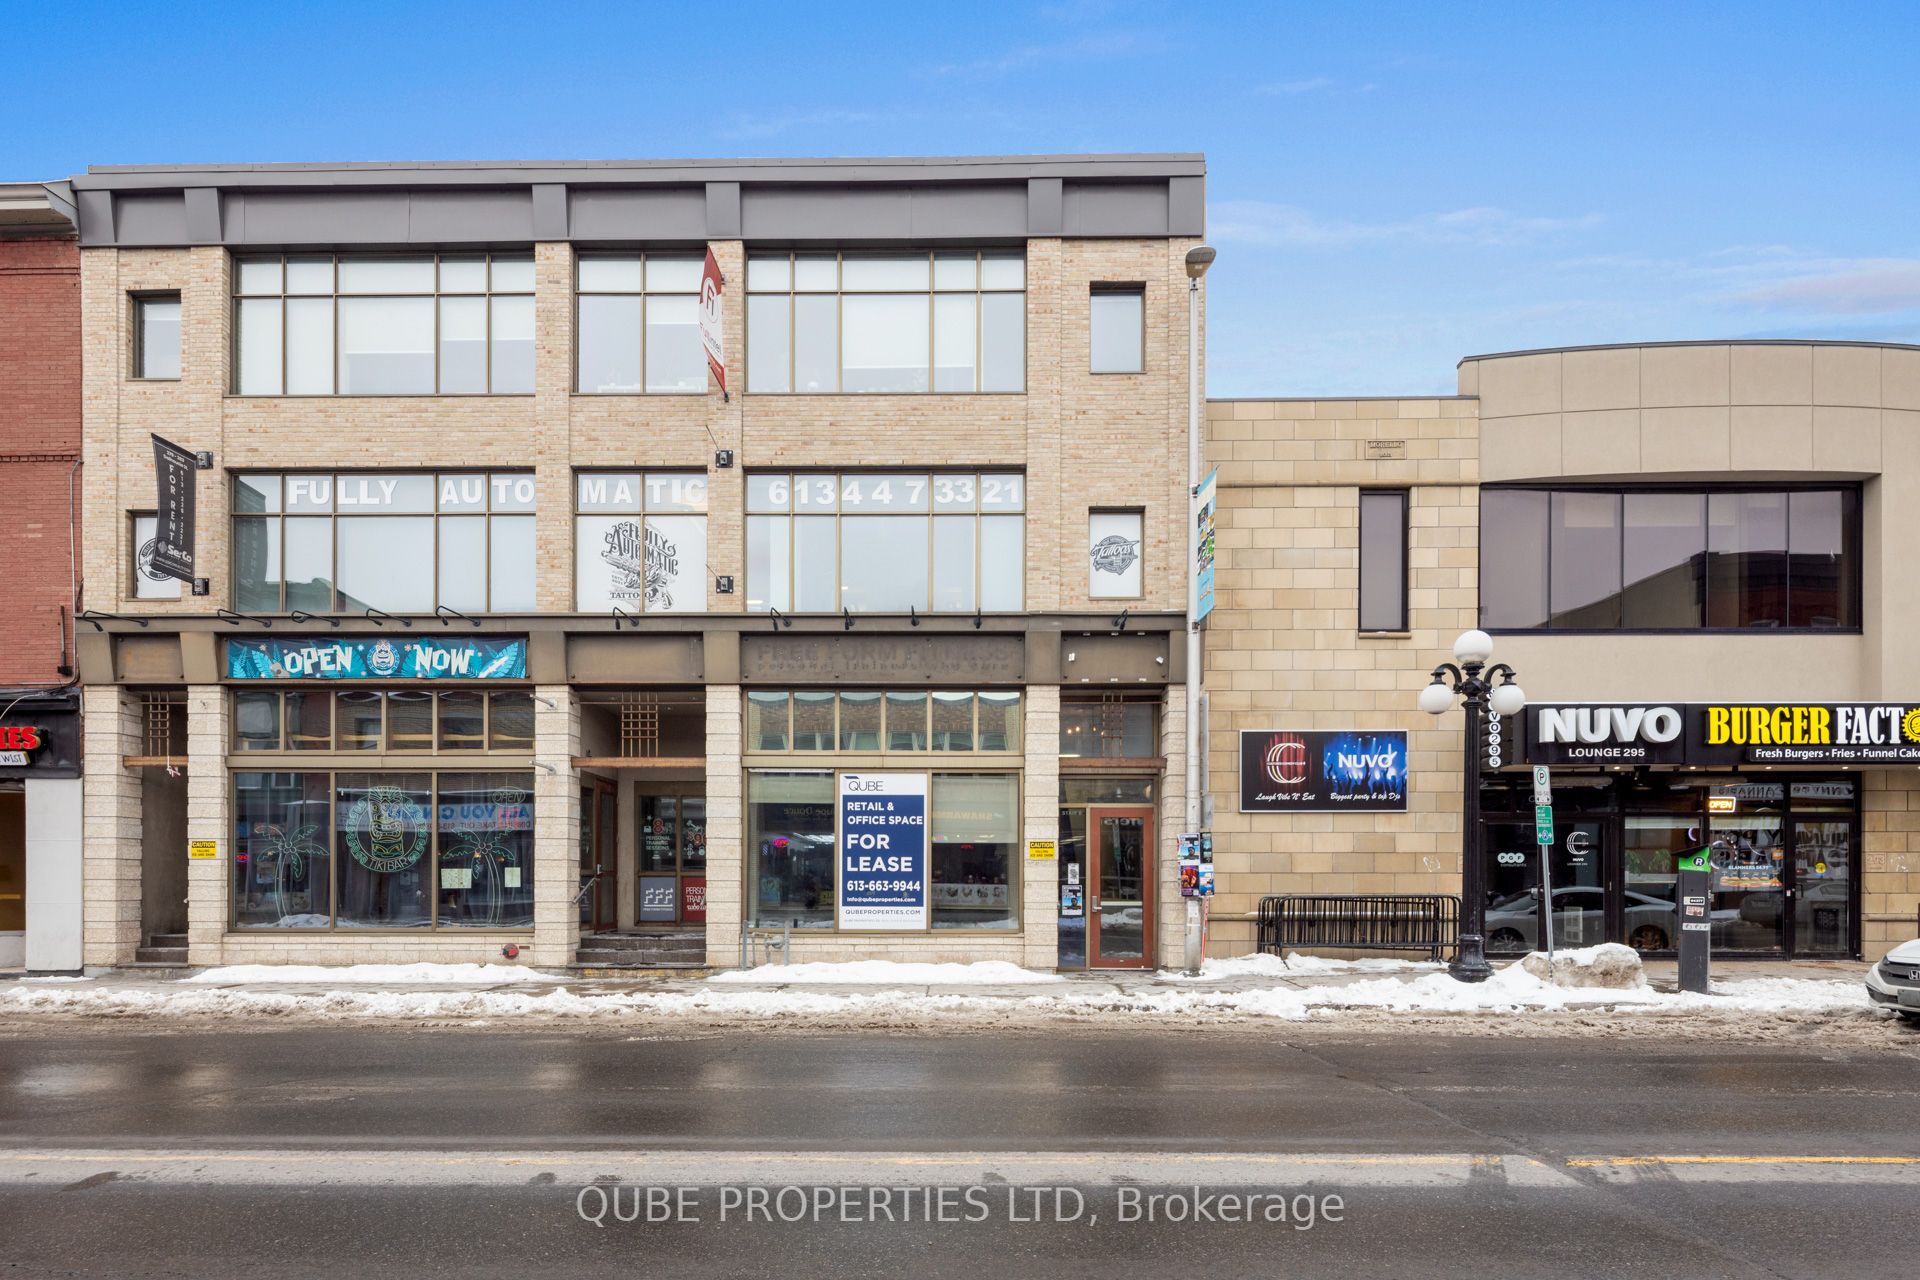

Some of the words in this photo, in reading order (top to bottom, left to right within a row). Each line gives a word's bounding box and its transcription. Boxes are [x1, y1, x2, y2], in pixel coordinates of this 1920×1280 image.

[288, 479, 398, 505] FULLY
[440, 478, 535, 504] AUTO
[284, 645, 352, 674] OPEN
[413, 644, 475, 675] NOW
[1538, 707, 1682, 744] NUVO
[1708, 706, 1831, 744] BURGER
[1568, 748, 1621, 757] LOUNGE
[1623, 748, 1645, 757] 295
[1755, 748, 1785, 758] Fresh
[1785, 748, 1824, 760] Burgers
[1832, 748, 1855, 758] Fries
[1863, 748, 1898, 758] Funnel
[1338, 752, 1394, 768] NUVO
[848, 781, 884, 792] QUBE
[1302, 792, 1316, 801] Eat
[1330, 792, 1352, 802] Biggest
[847, 802, 885, 811] RETAIL
[886, 802, 895, 811] &
[1710, 800, 1732, 809] OPEN
[848, 815, 886, 825] OFFICE
[888, 815, 924, 825] SPACE
[847, 834, 890, 850] FOR
[847, 856, 913, 872] LEASE
[847, 880, 921, 892] 613-663-9944
